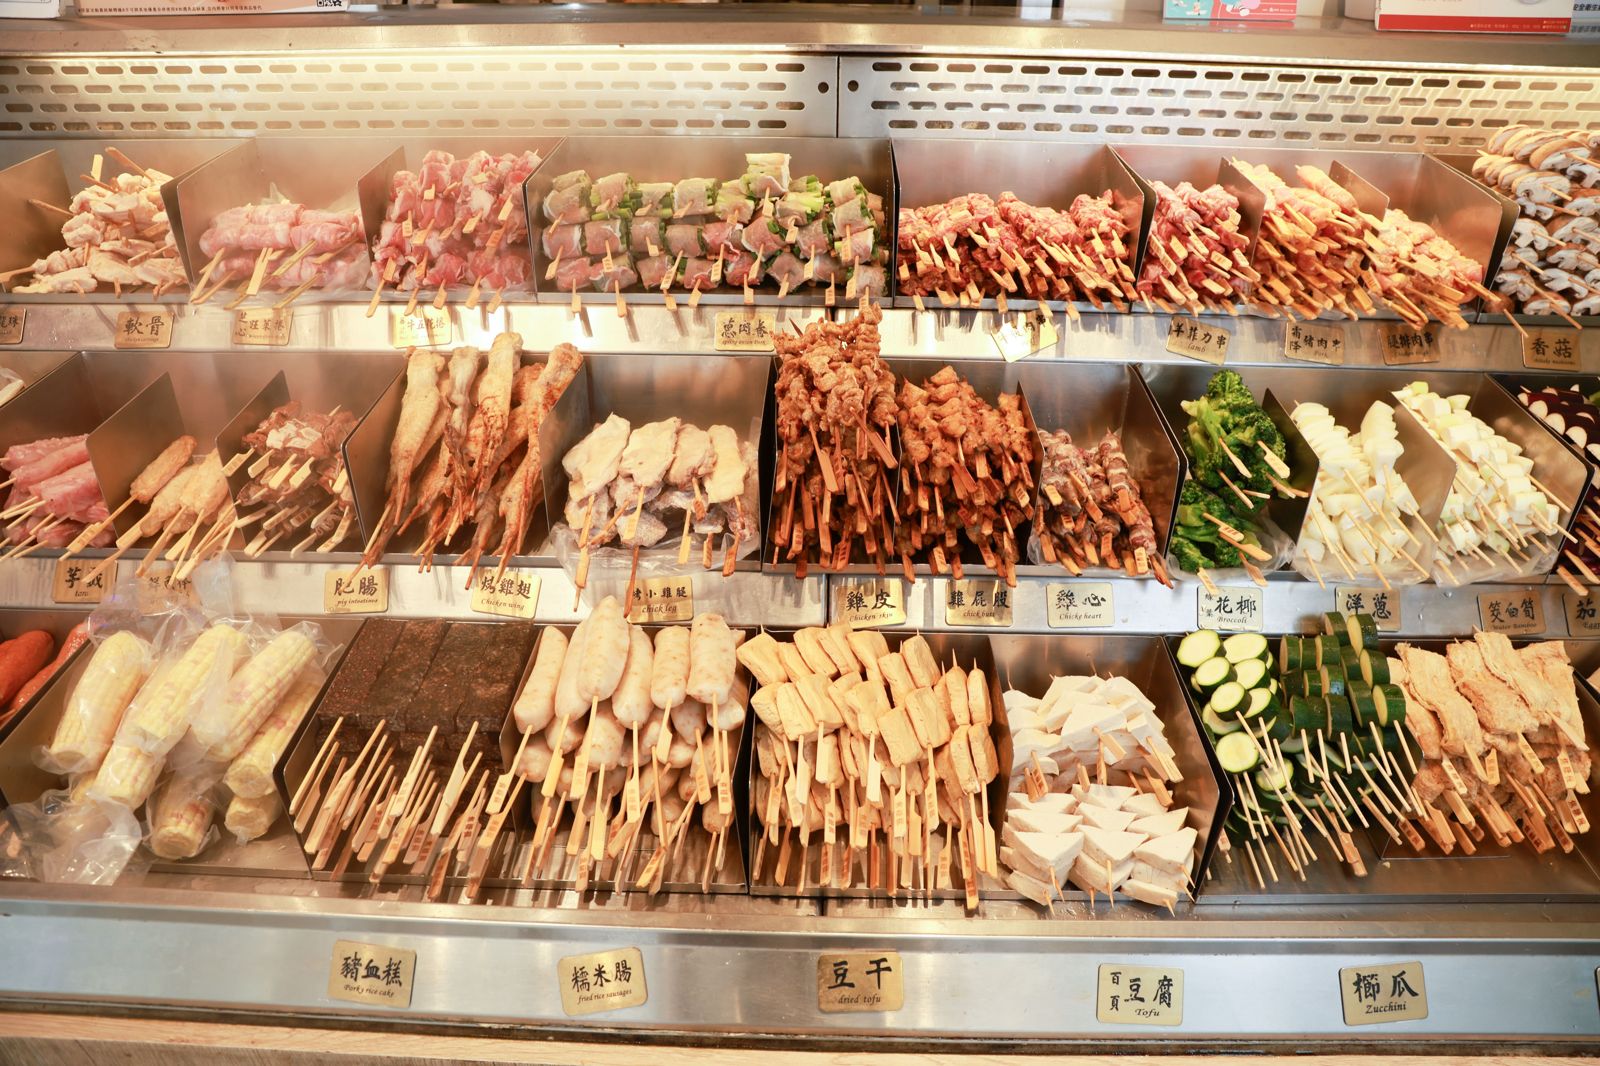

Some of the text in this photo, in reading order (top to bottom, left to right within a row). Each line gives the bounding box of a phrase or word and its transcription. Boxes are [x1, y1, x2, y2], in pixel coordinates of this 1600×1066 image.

[123, 316, 164, 336] 軟骨
[1173, 323, 1226, 349] 羊菲力串
[1530, 338, 1573, 358] 香菇
[334, 576, 378, 596] 肥腸
[481, 576, 532, 599] 烤雞翅
[846, 589, 896, 612] 雞皮
[949, 590, 1010, 609] 雞屁股
[1214, 595, 1257, 618] 花椰
[1346, 592, 1392, 619] 洋蔥
[1576, 598, 1597, 620] 茄
[849, 612, 876, 622] Chicken
[1084, 613, 1102, 621] heart
[1216, 616, 1247, 624] Broccoli
[340, 952, 402, 987] 豬血糕
[571, 959, 632, 993] 糯米腸
[827, 957, 892, 990] 豆干
[378, 989, 395, 998] cake
[1109, 971, 1122, 1011] 百頁
[1124, 975, 1174, 1008] 豆腐
[1352, 970, 1419, 1003] 櫛瓜
[577, 993, 593, 1005] fried
[594, 992, 605, 1001] rice
[838, 994, 881, 1006] dried tofu
[1365, 1001, 1407, 1015] Zucchini
[1134, 1008, 1160, 1018] Tofu
